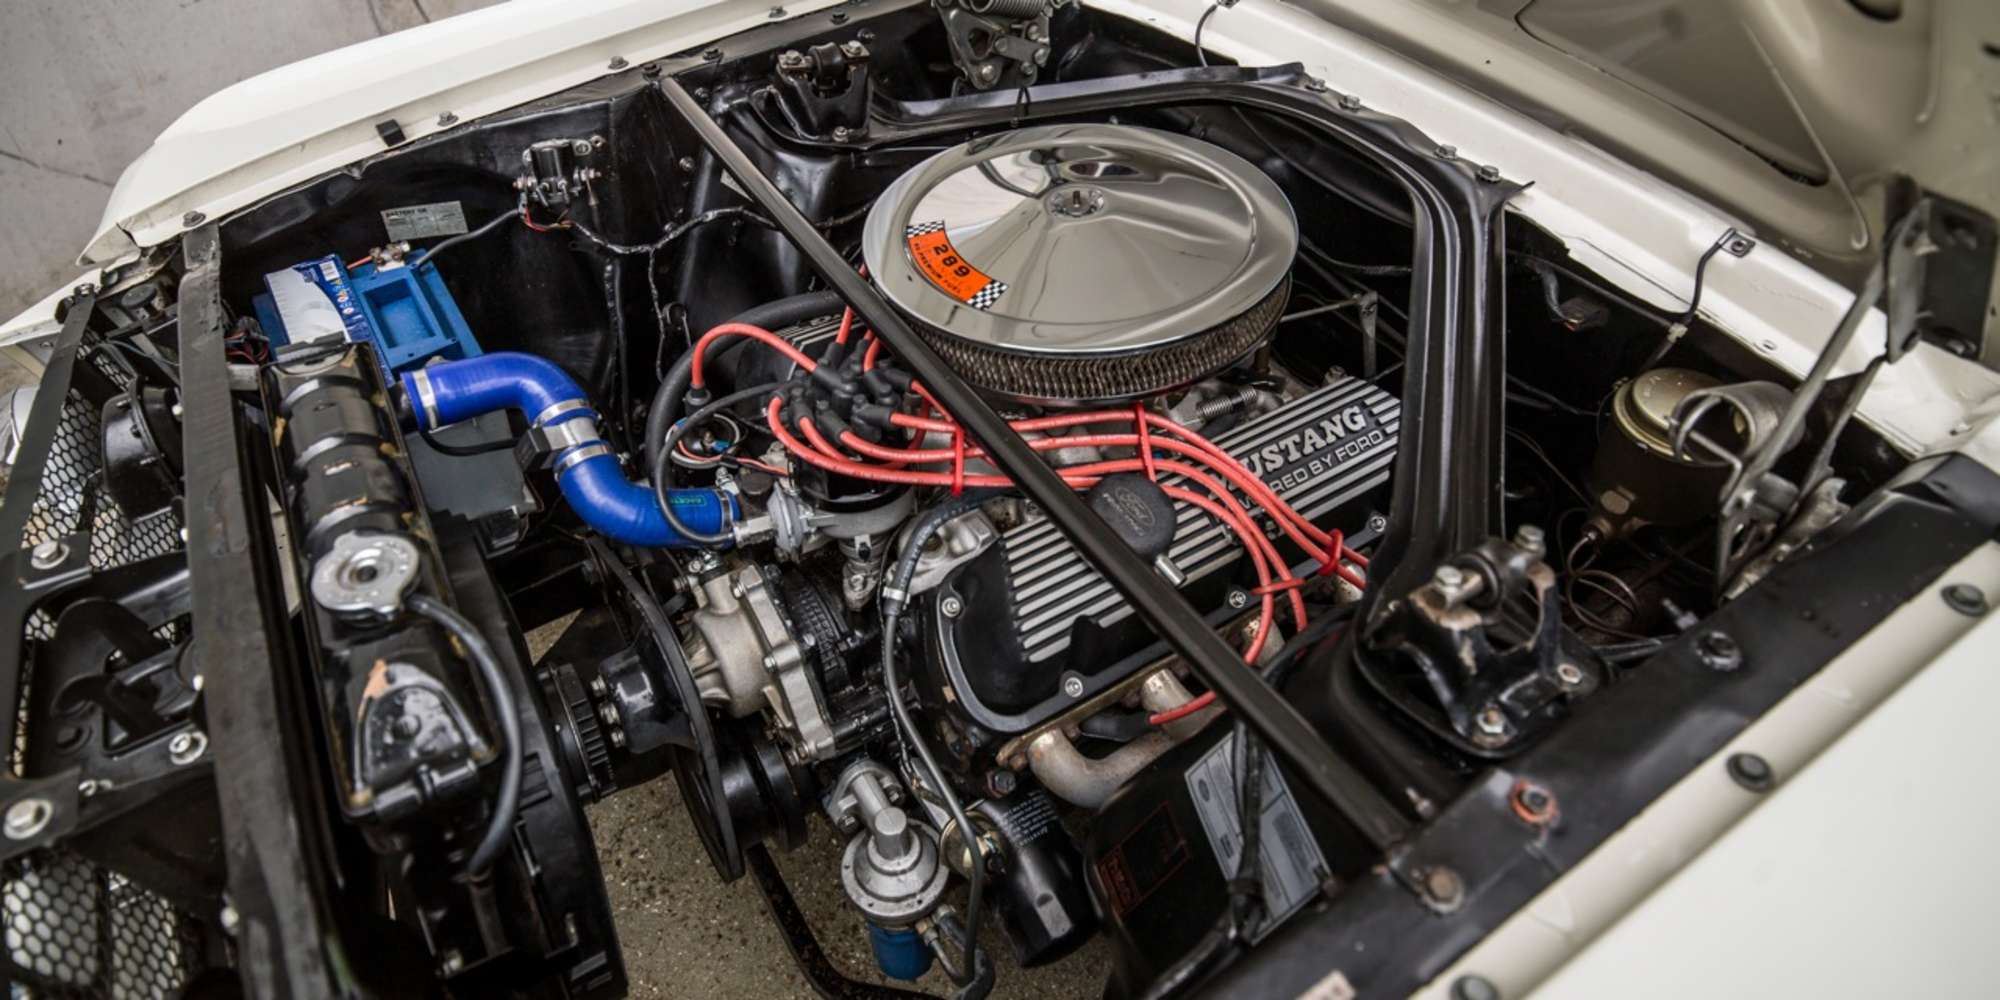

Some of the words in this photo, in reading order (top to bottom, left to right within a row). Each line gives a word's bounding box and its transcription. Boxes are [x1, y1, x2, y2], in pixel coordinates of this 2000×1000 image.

[933, 243, 971, 278] 289
[1222, 405, 1367, 488] USTANG
[1309, 453, 1333, 476] BY
[1335, 430, 1384, 462] FORD
